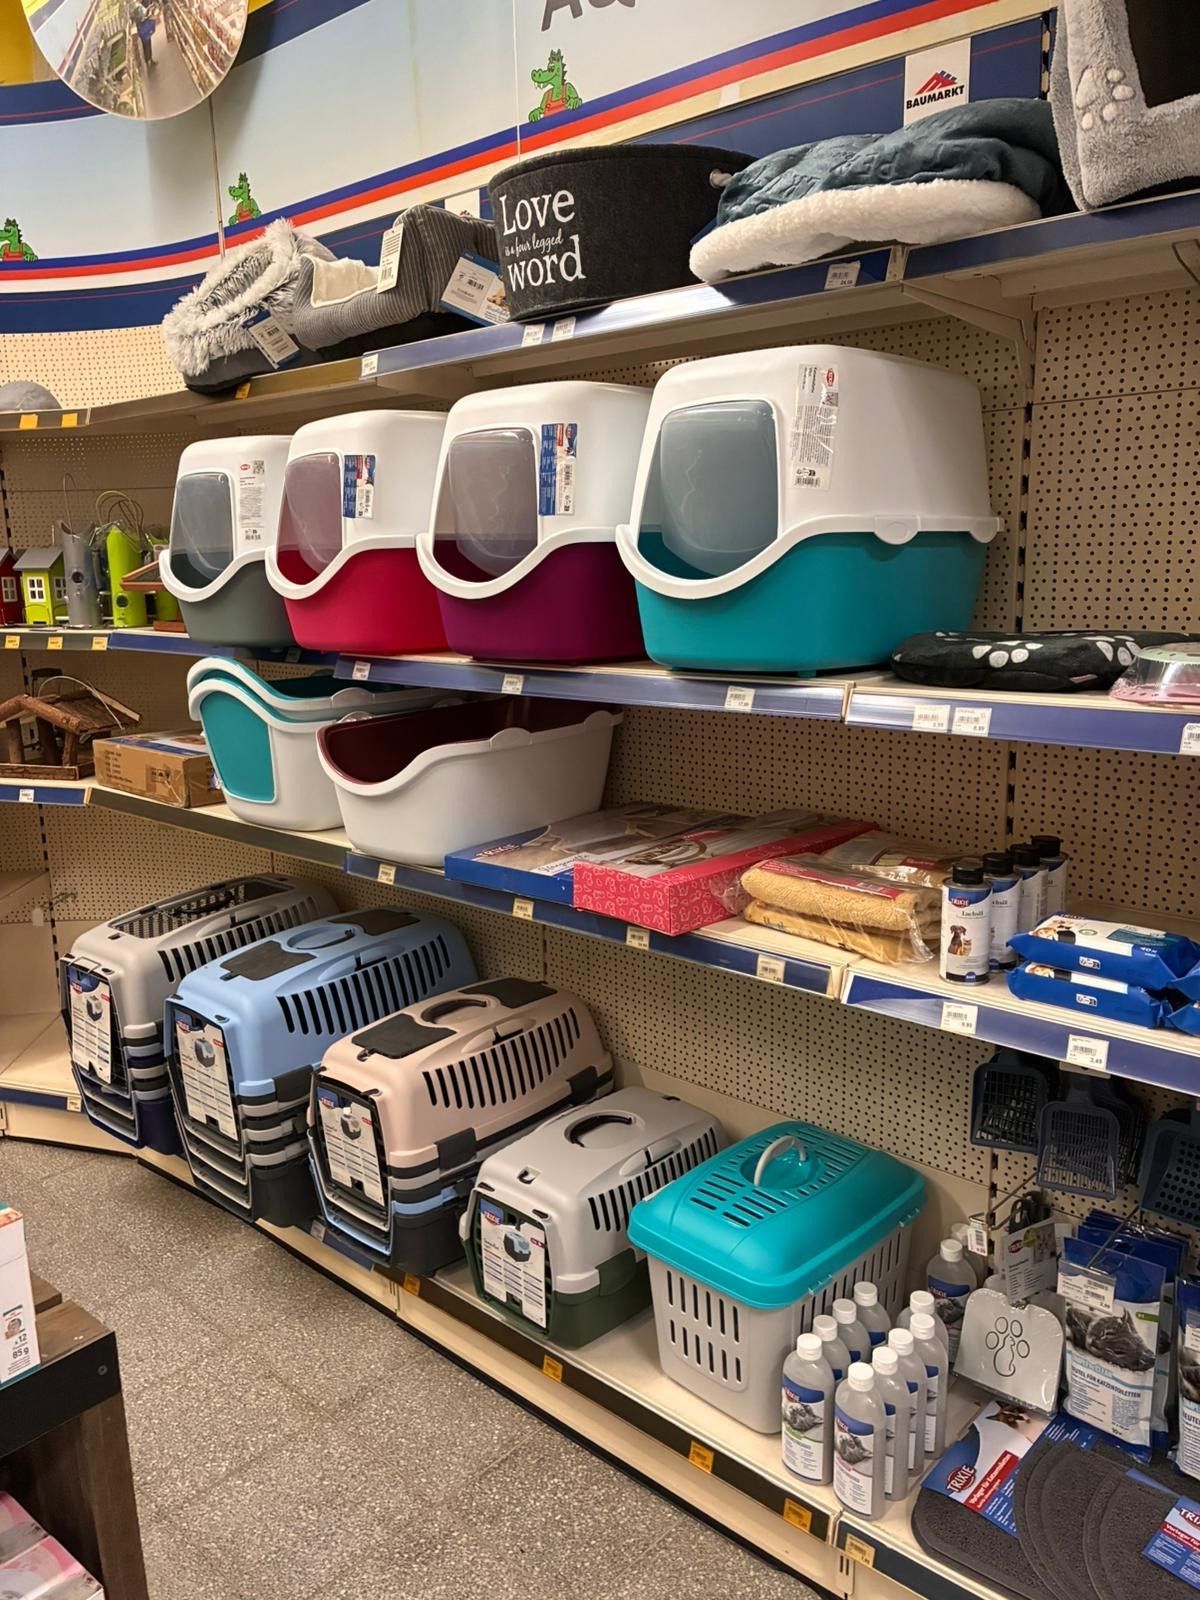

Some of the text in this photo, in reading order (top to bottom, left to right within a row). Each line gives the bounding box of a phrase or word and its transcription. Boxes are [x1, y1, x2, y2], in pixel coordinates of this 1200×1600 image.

[906, 85, 965, 110] BAUMARKT
[499, 190, 575, 236] Love
[532, 228, 563, 254] legged
[507, 234, 587, 292] word
[947, 1465, 975, 1492] TRIXIE
[1180, 1508, 1200, 1526] TRI
